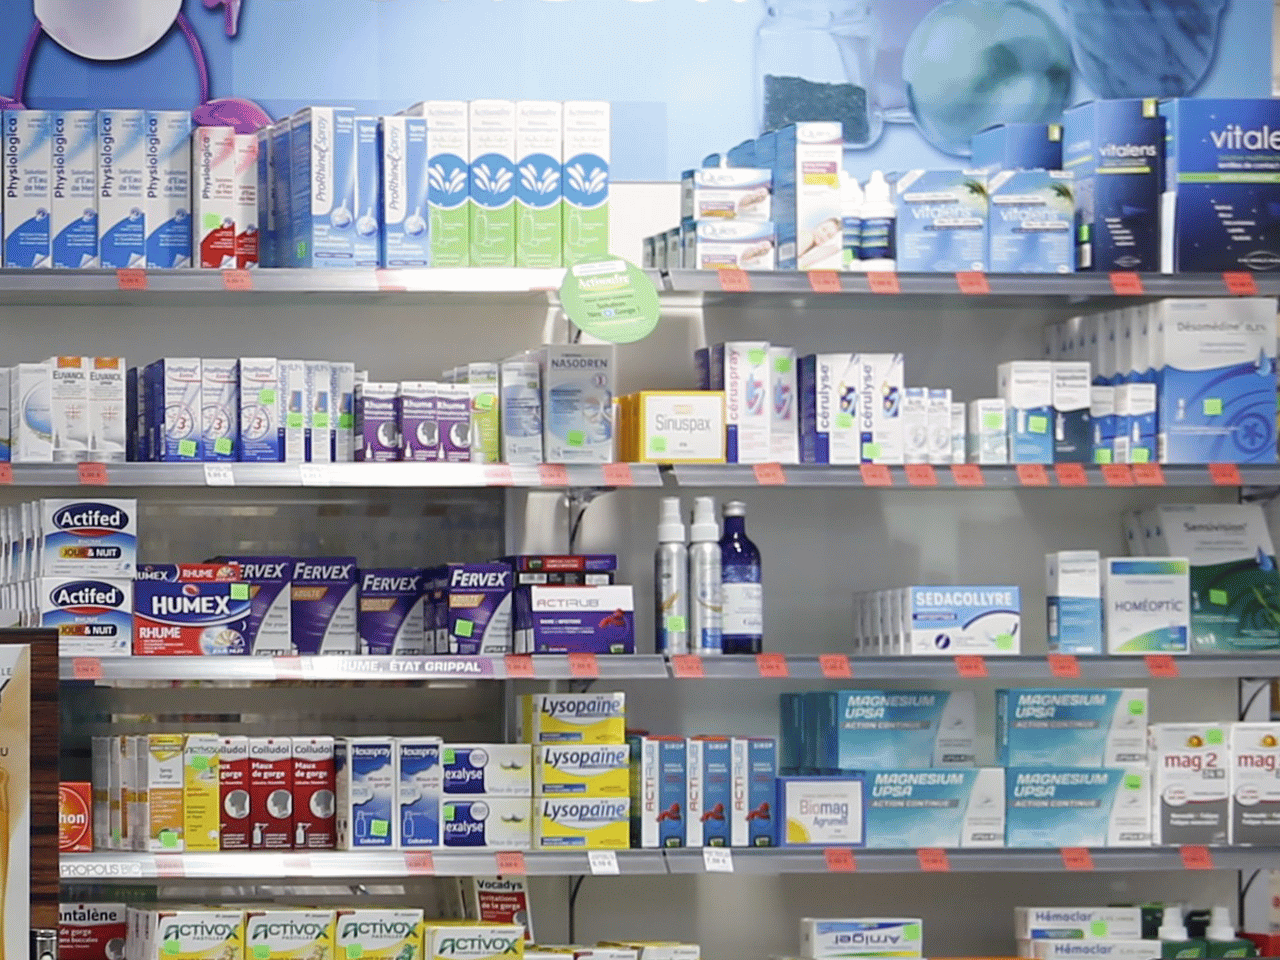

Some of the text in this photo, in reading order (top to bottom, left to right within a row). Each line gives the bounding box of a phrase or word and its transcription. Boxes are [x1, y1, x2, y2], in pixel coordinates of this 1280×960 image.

[1098, 142, 1156, 158] vitalens
[550, 358, 608, 369] NASODREN
[819, 362, 830, 429] cérulyse
[655, 415, 712, 438] Sinuspax
[60, 510, 121, 528] Actifed
[293, 563, 353, 582] FERVEX
[59, 587, 118, 605] Actifed
[152, 594, 230, 615] HUMEX
[916, 591, 1012, 607] SEDACOLLYRE
[139, 626, 181, 640] RHUME
[390, 657, 482, 673] ÉTAT GRIPPAL
[543, 696, 621, 716] Lysopaïne
[847, 696, 936, 707] MAGNESIUM
[845, 707, 886, 719] UPSA
[251, 744, 290, 756] Colludol
[544, 746, 625, 769] Lysopaïne
[1165, 752, 1218, 773] mag 2
[60, 863, 117, 875] PROPOLIS
